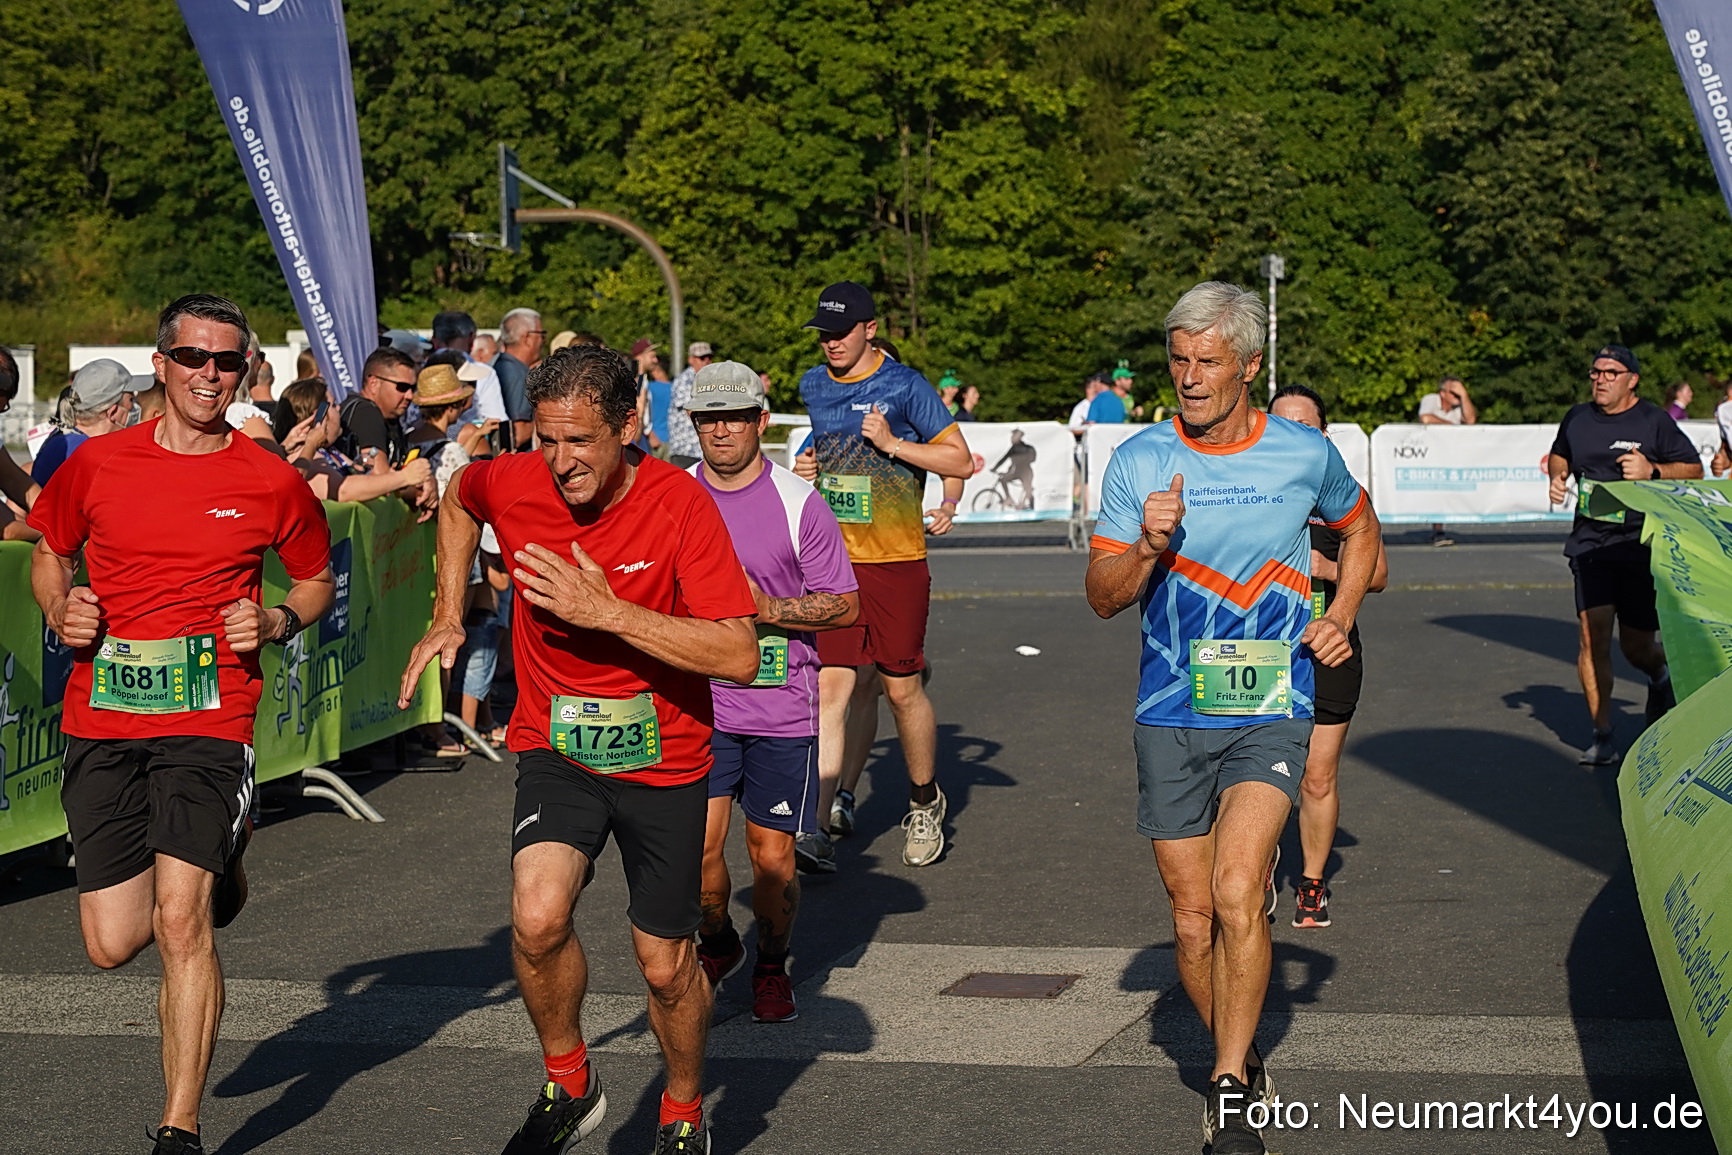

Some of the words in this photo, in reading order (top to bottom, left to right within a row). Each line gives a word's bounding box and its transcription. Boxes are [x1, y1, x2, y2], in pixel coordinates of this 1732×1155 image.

[697, 384, 717, 394] KEEP
[718, 384, 746, 393] GOING
[1394, 447, 1429, 459] NOW
[1396, 469, 1446, 481] E-BIKES
[1189, 485, 1257, 497] Raiffeisenbank
[861, 494, 869, 517] 2022
[1189, 497, 1235, 507] Neumarkt
[1237, 495, 1269, 505] i.d.OPf.
[1271, 495, 1284, 504] eG
[215, 508, 237, 518] DEHN
[623, 560, 645, 574] DEHN
[1314, 596, 1322, 619] 2022
[113, 652, 142, 660] Firmenlauf
[760, 646, 775, 665] 5
[775, 648, 784, 677] 2022
[97, 667, 106, 694] RUN
[107, 662, 168, 690] 1681
[174, 667, 184, 702] 2022
[1225, 665, 1257, 690] 10
[111, 688, 139, 701] Pöppel
[141, 691, 168, 701] Josef
[1196, 673, 1204, 699] RUN
[1277, 670, 1286, 704] 2022
[1216, 692, 1237, 700] Fritz
[1240, 692, 1265, 700] Franz
[569, 723, 644, 750] 1723
[646, 721, 656, 756] 2022
[570, 751, 602, 761] Pfister
[606, 747, 644, 760] Norbert
